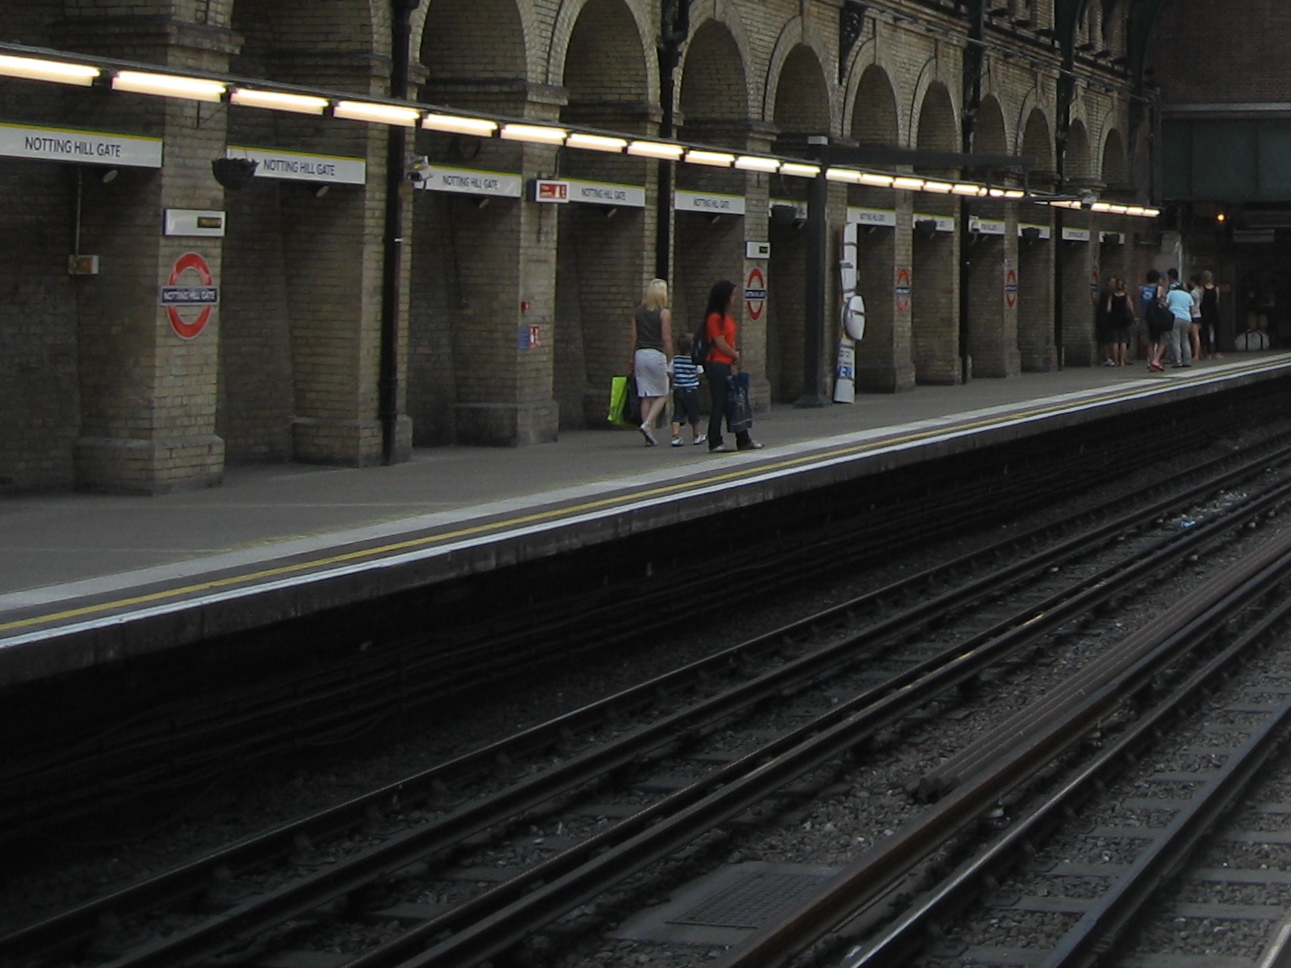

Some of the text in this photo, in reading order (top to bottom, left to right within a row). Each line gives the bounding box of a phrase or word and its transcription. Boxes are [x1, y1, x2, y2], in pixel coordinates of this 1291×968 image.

[25, 136, 121, 158] NOTTING HILL GATE
[263, 159, 335, 176] NOTTING HILL GATE
[442, 175, 498, 190] NOTTING HILL GATE
[163, 291, 215, 300] NOTTING HILL GATE
